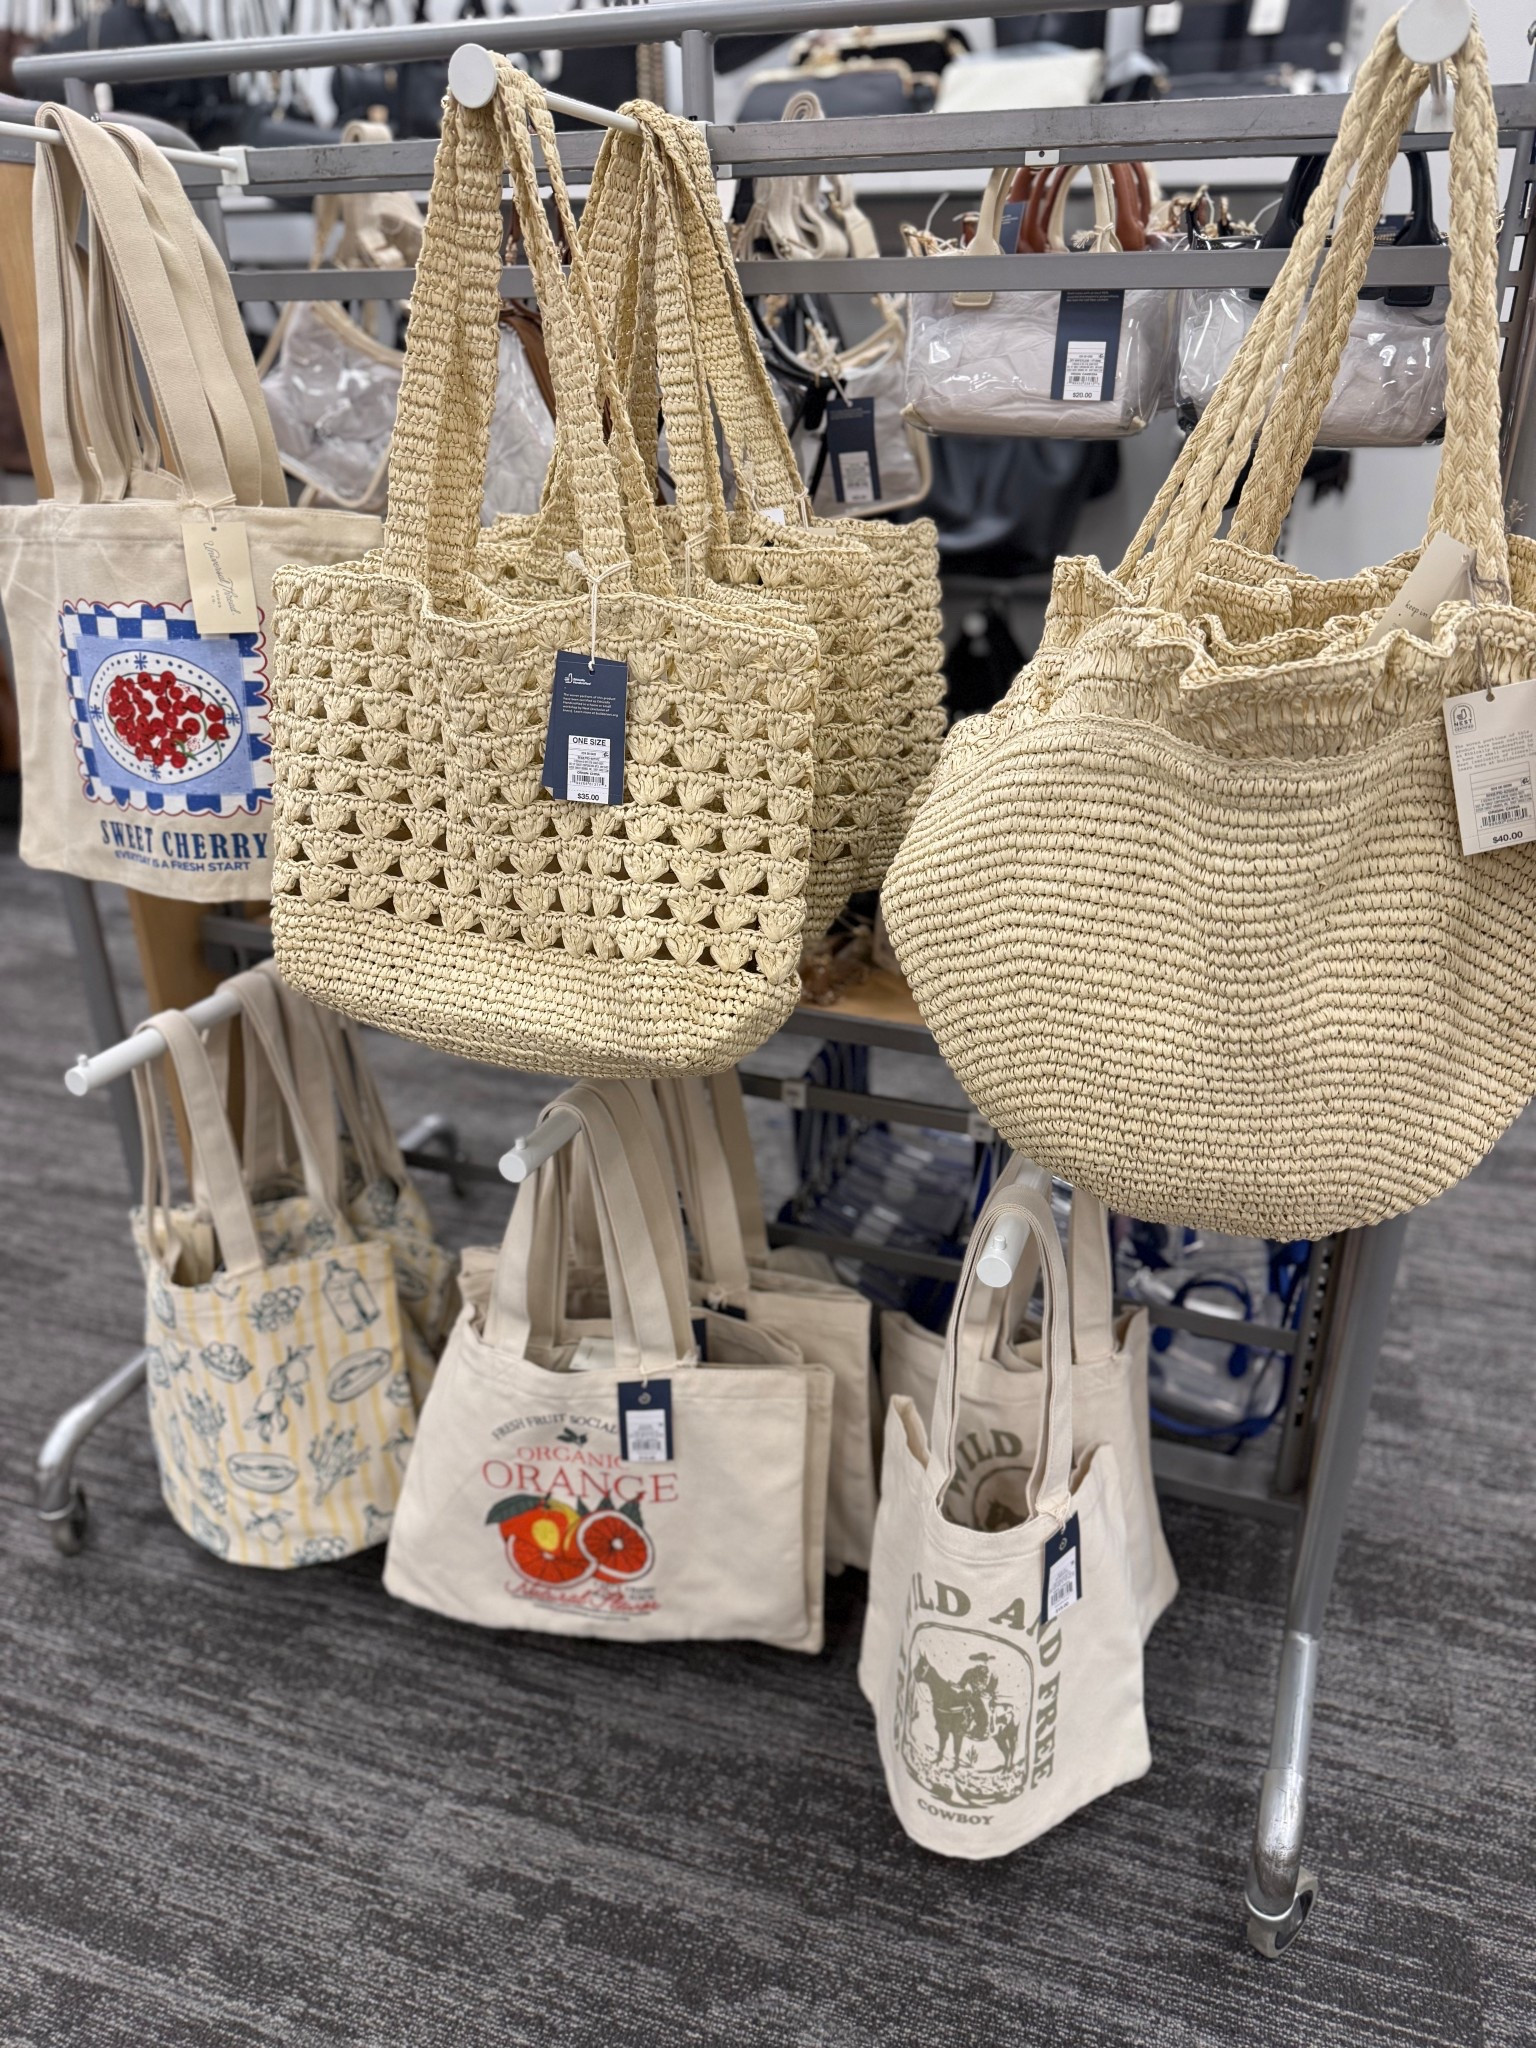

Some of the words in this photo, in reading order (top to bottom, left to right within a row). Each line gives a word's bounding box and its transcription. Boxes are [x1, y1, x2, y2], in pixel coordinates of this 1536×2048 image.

[1404, 600, 1420, 618] keep
[1454, 719, 1473, 727] NEST
[573, 737, 588, 745] ONE
[577, 793, 600, 801] $35.00
[100, 820, 153, 853] SWEET
[162, 831, 268, 860] CHERRY
[1493, 831, 1523, 844] $40.00
[161, 860, 170, 869] A
[171, 861, 205, 872] FRESH
[208, 862, 251, 872] START
[491, 1417, 526, 1441] FRESH
[526, 1413, 567, 1428] FRUIT
[569, 1416, 619, 1435] SOCIAL
[517, 1446, 630, 1471] ORGANIC
[482, 1460, 679, 1504] ORANGE
[1030, 1670, 1061, 1790] FREE
[917, 1798, 994, 1825] COWBOY
